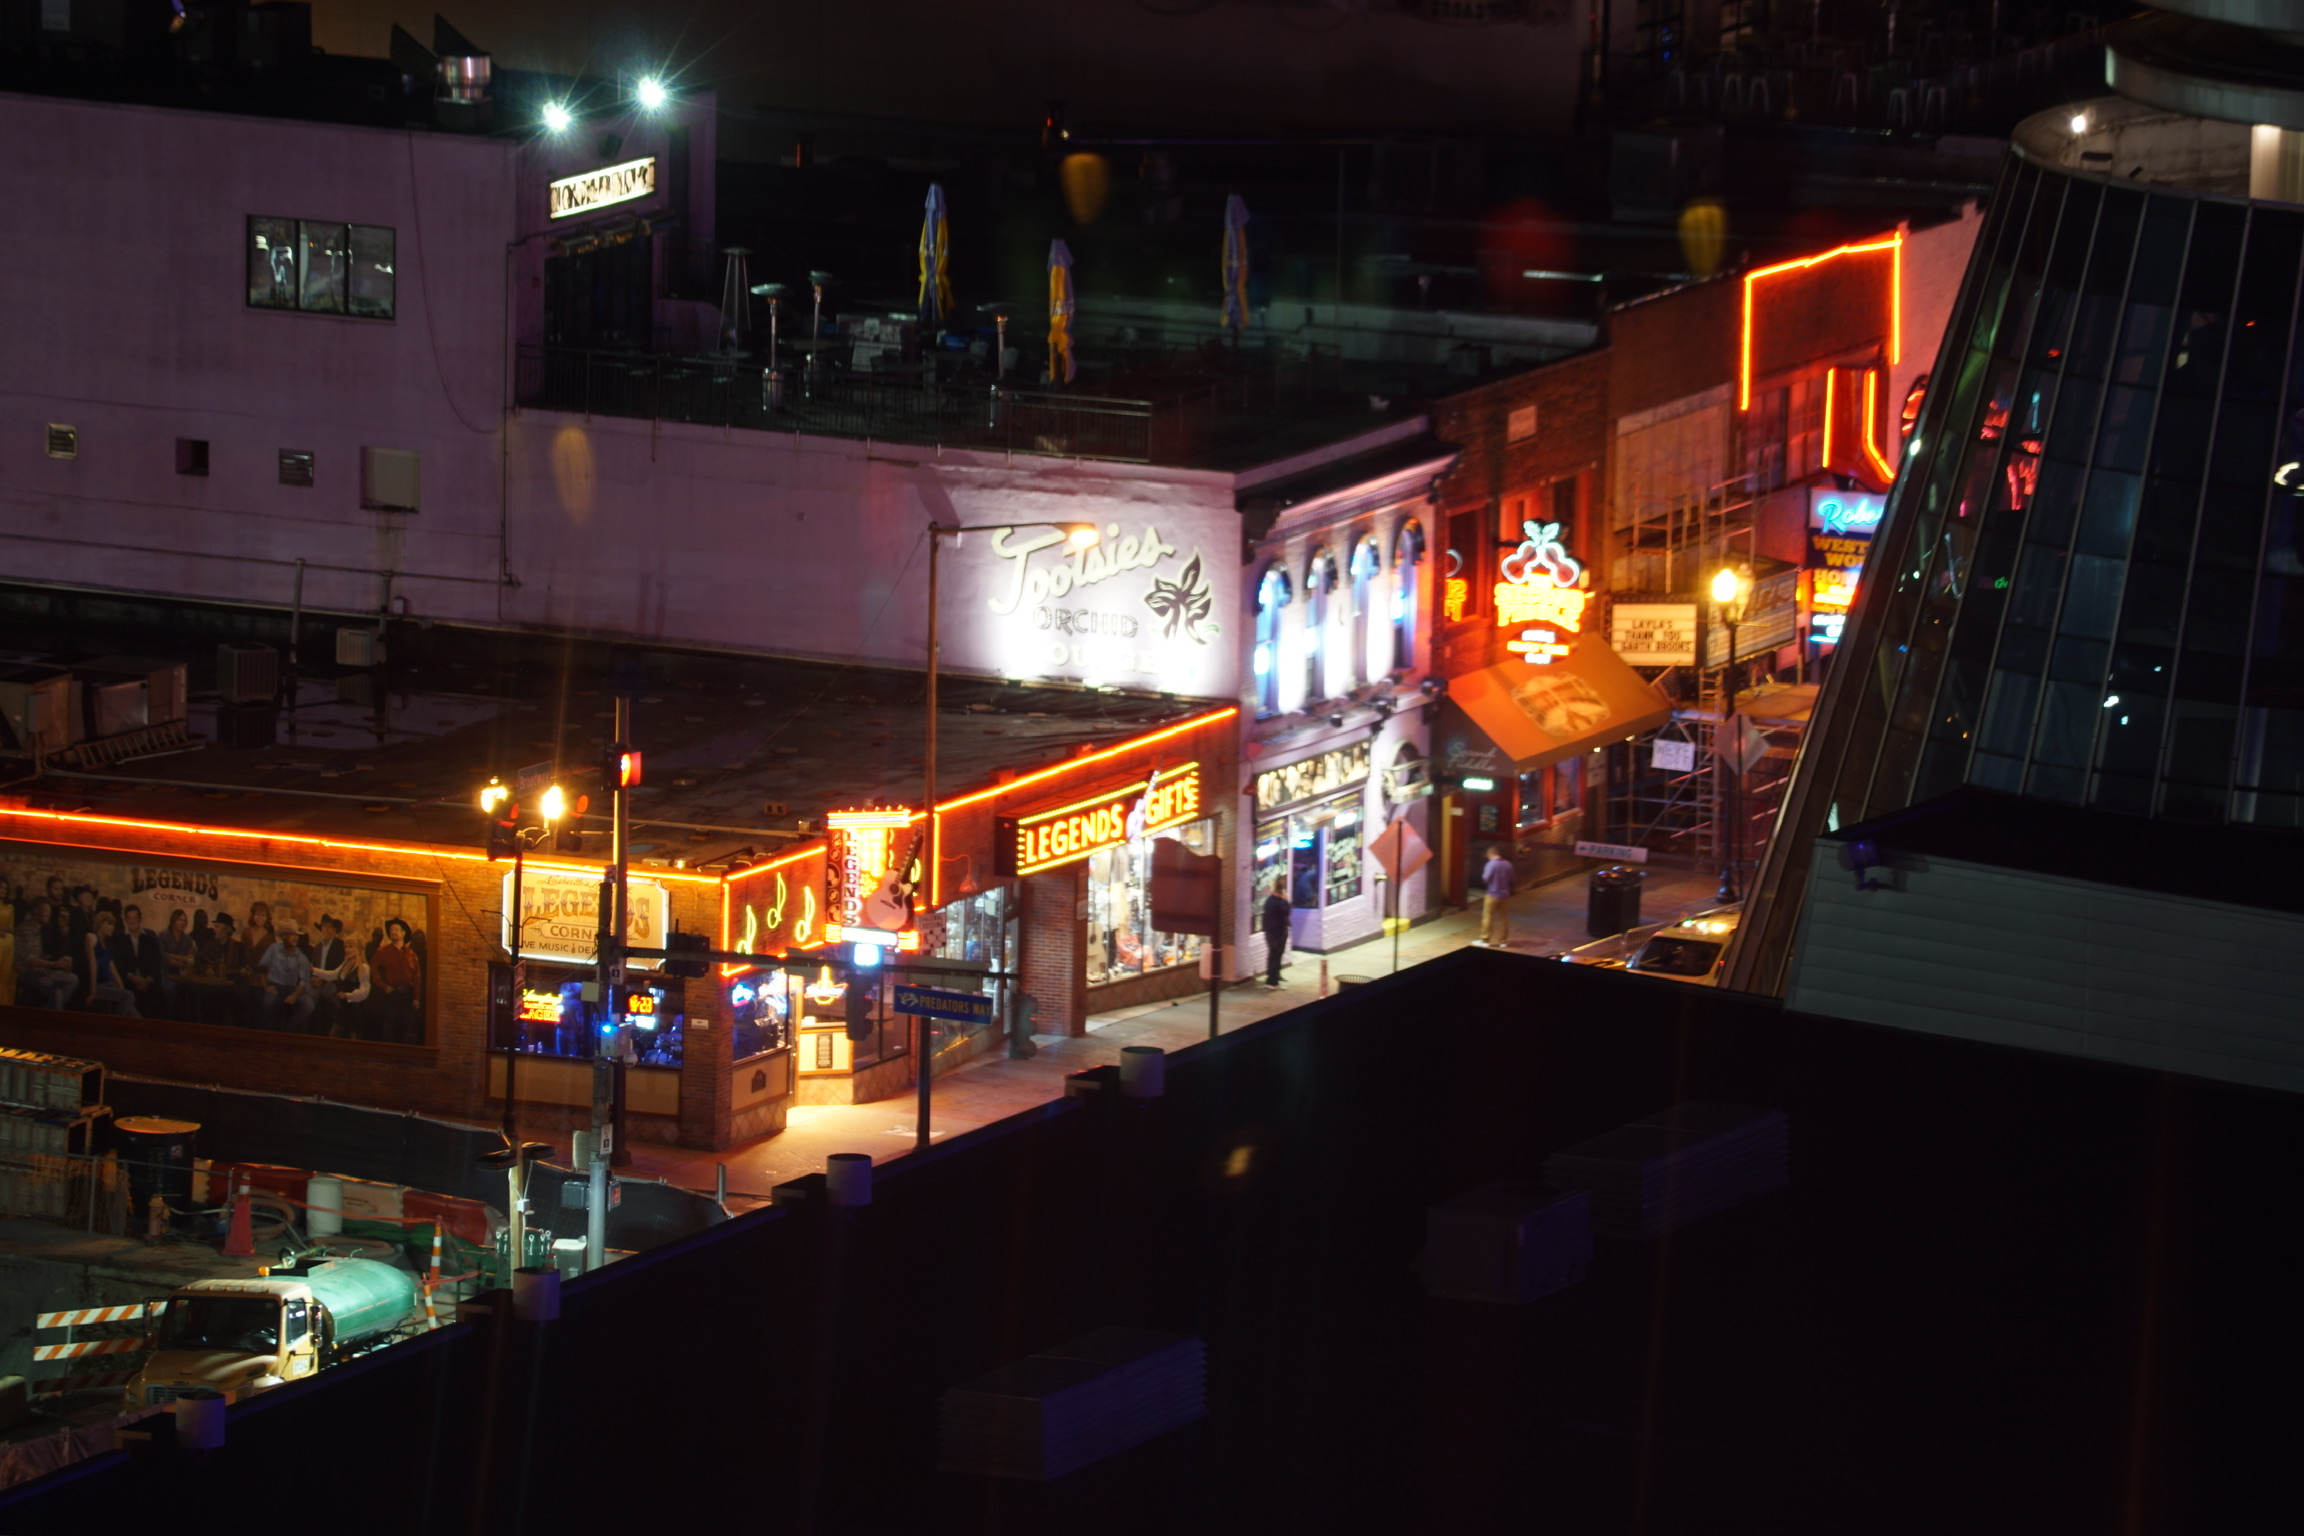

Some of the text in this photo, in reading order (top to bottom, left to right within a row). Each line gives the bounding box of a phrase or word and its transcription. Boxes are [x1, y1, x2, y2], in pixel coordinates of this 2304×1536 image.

[1812, 535, 1872, 554] WEST
[987, 523, 1177, 616] Tootsies
[1033, 606, 1139, 639] ORCHID
[1663, 631, 1681, 641] YOU
[1026, 778, 1196, 864] LEGENDS GIFTS
[1590, 845, 1632, 858] PARKING
[132, 867, 218, 901] LEGENDS
[842, 828, 863, 926] LEGENDS
[154, 893, 196, 903] CORNER
[523, 887, 650, 939] LEGES
[550, 925, 598, 940] CORN
[539, 943, 569, 952] MUSIC
[919, 995, 992, 1016] PREDATORS WAY
